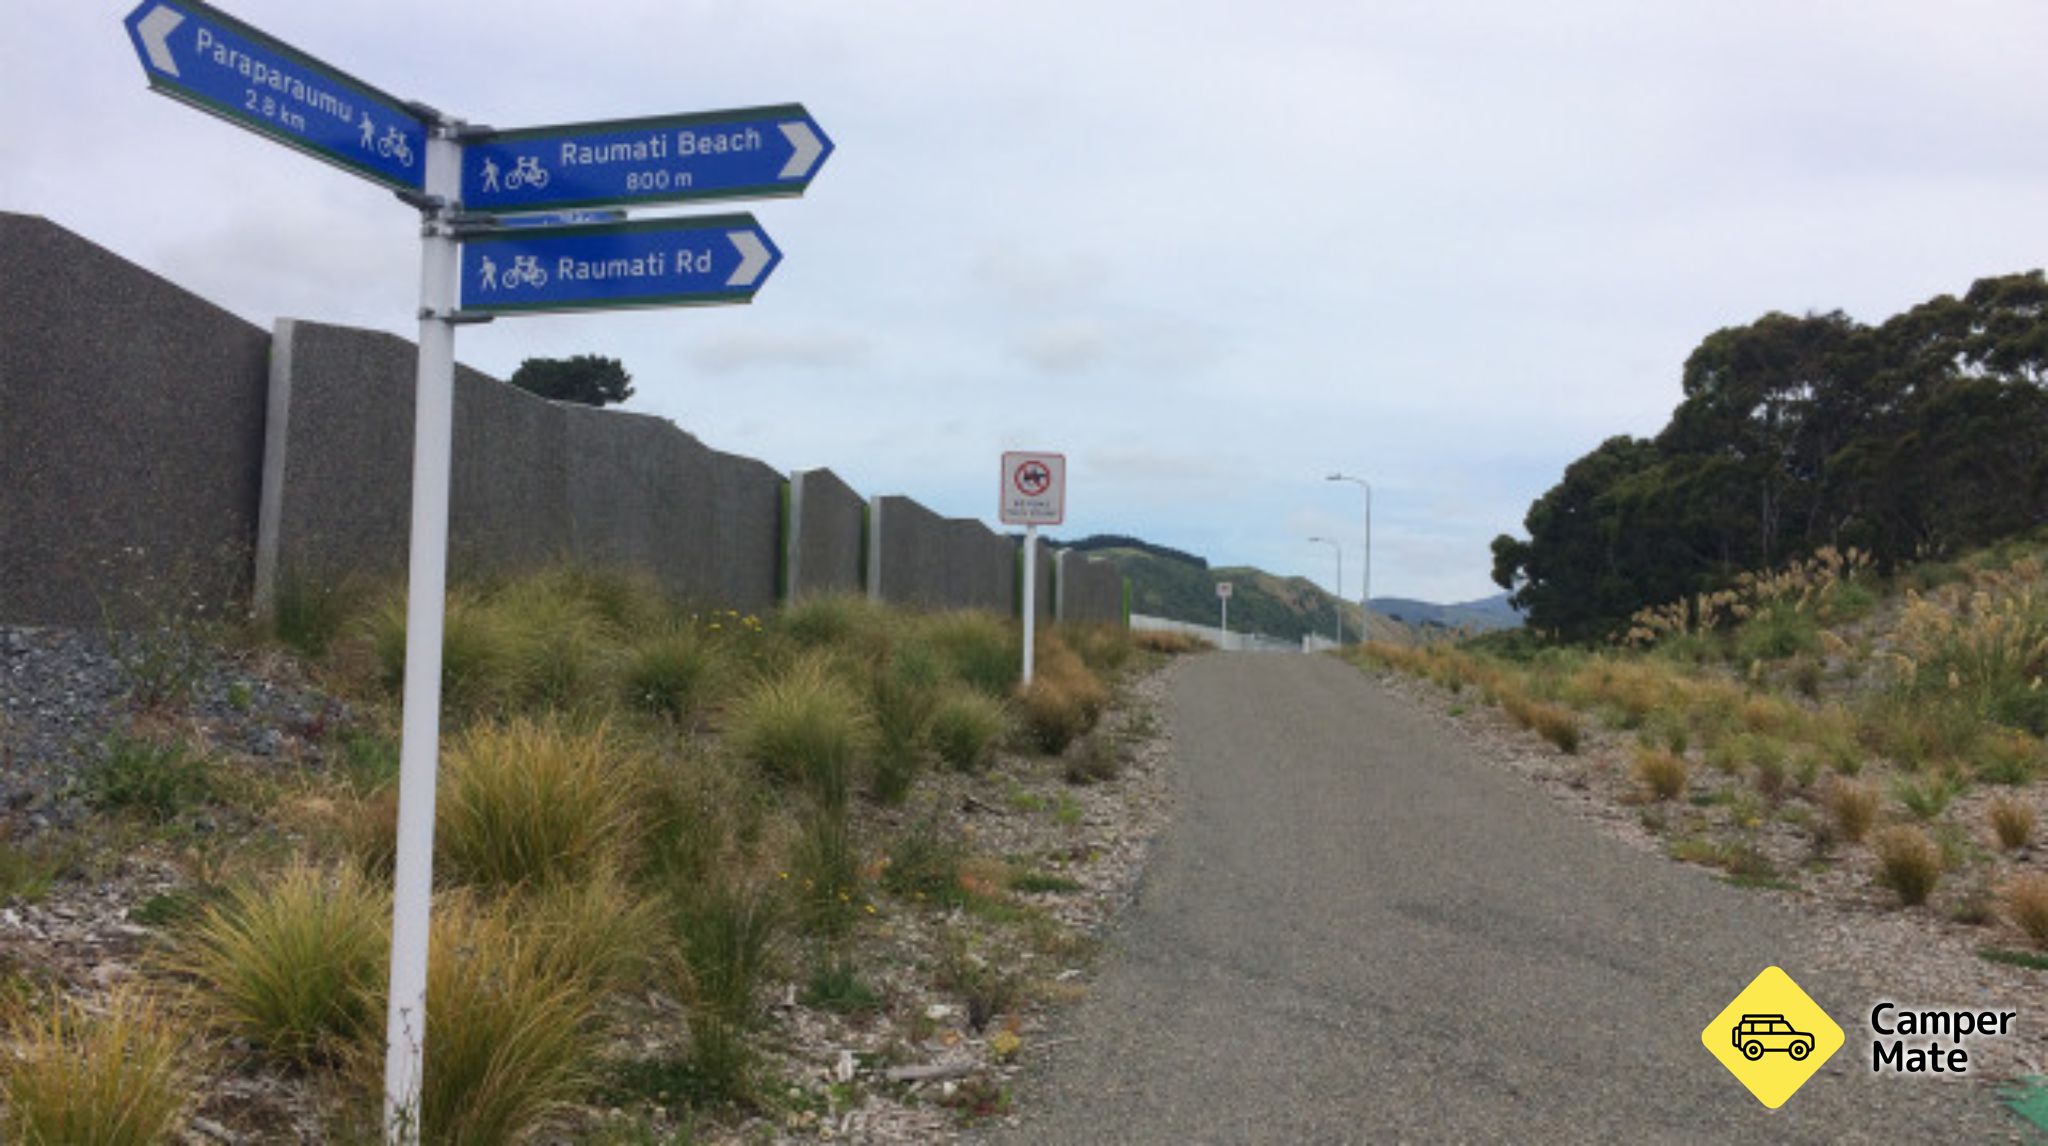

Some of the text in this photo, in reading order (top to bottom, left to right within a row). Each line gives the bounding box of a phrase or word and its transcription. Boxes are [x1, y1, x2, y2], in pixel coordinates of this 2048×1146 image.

[197, 28, 352, 121] Paraparaumu
[281, 104, 305, 131] km
[561, 128, 760, 165] Raumati Beach
[626, 172, 692, 190] 800 m
[557, 250, 713, 281] Raumati Rd
